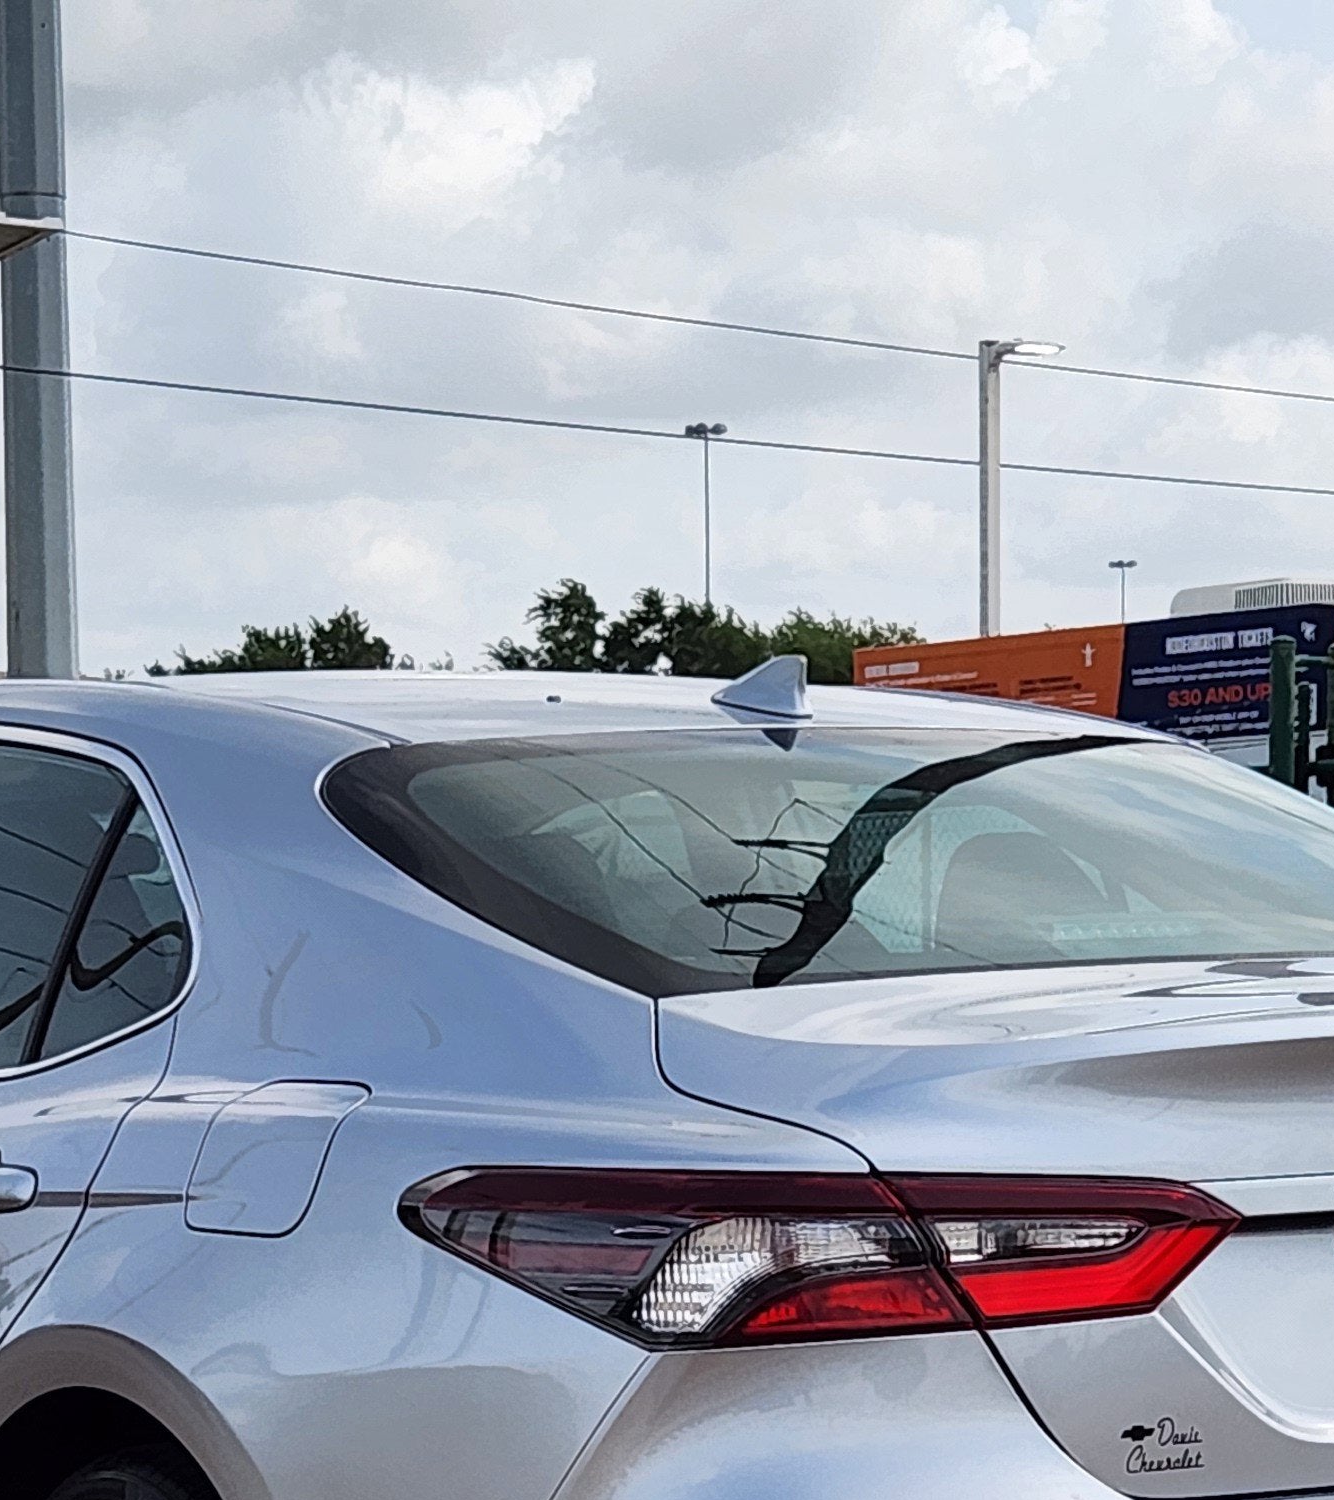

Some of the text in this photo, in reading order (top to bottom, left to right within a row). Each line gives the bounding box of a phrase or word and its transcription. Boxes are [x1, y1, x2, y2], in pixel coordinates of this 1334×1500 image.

[1205, 685, 1243, 704] AND
[1247, 683, 1273, 700] UP
[1156, 1416, 1203, 1446] Davis
[1125, 1444, 1205, 1474] Chevrolet
